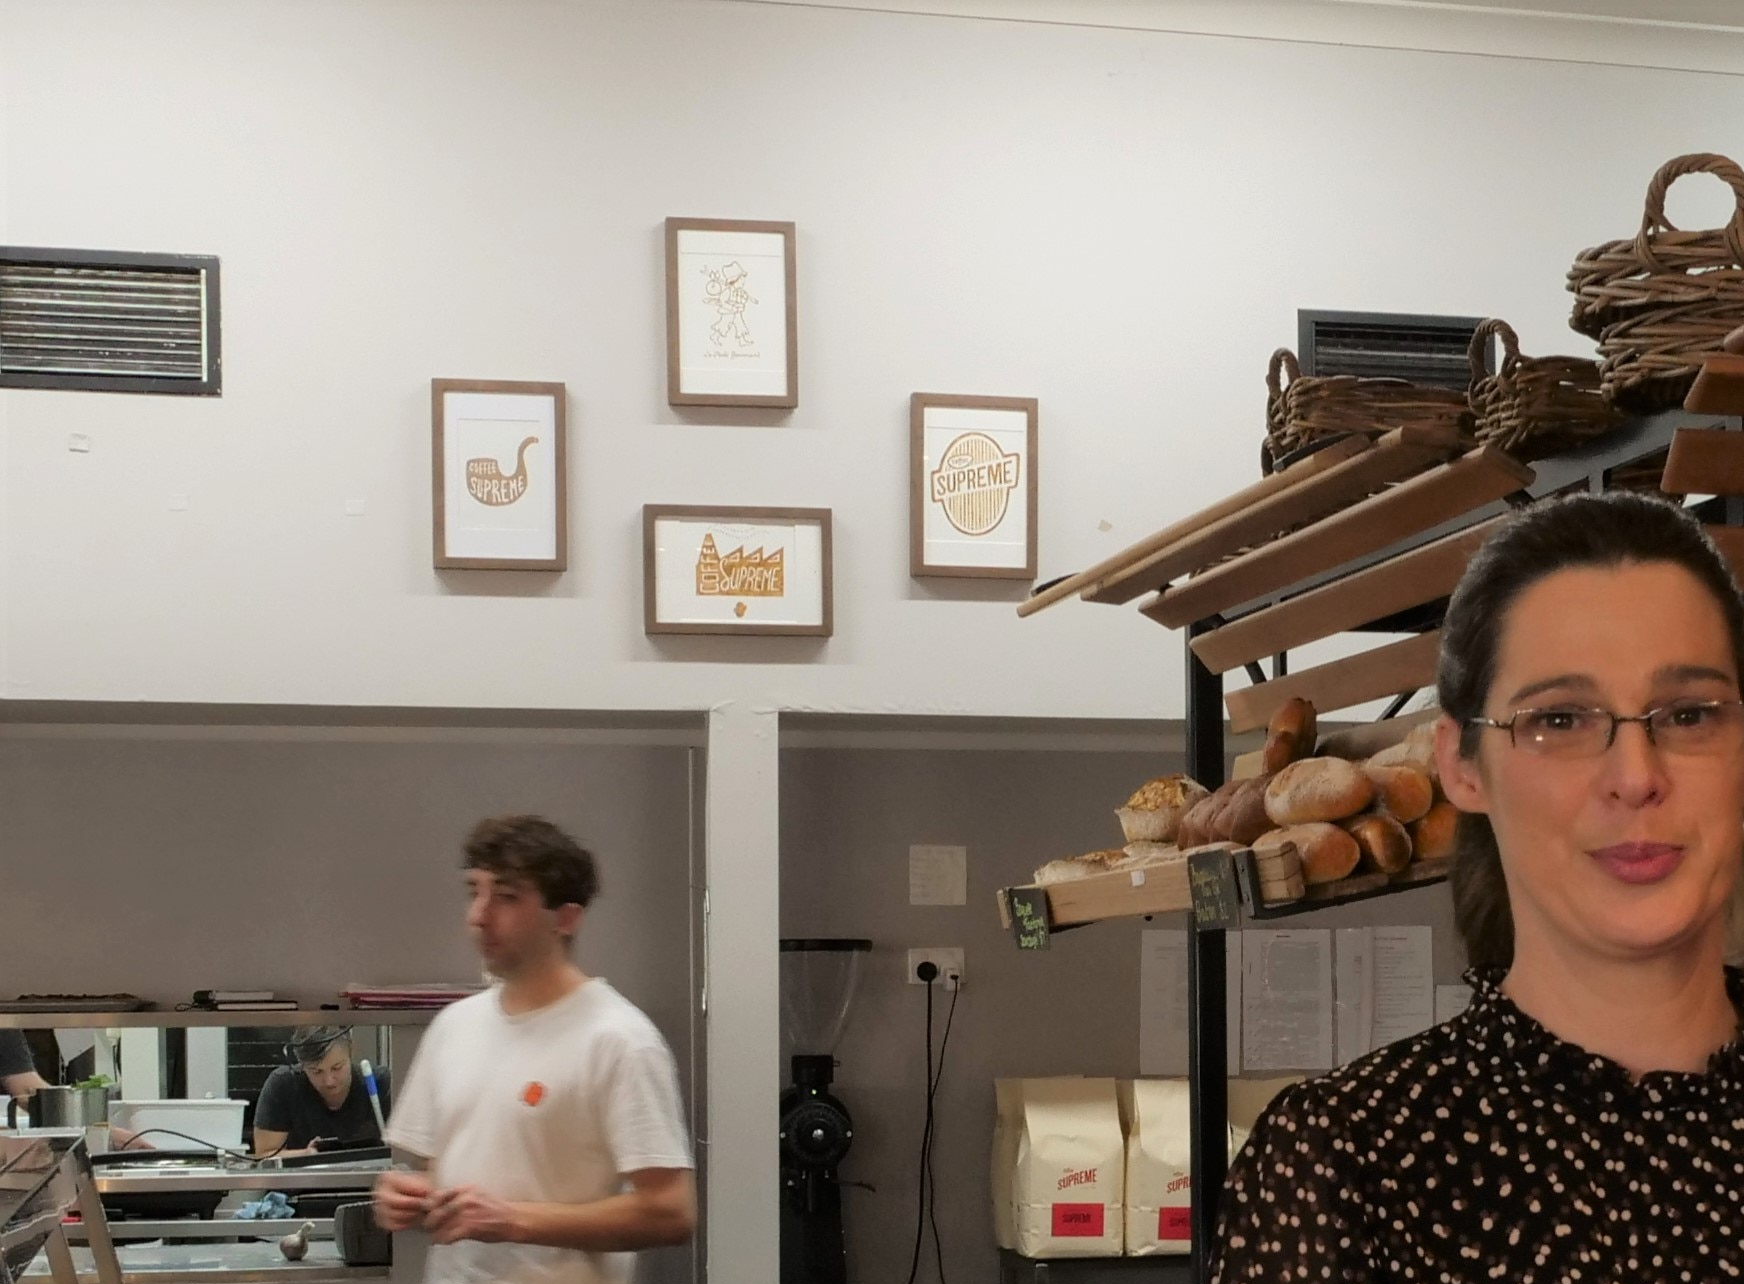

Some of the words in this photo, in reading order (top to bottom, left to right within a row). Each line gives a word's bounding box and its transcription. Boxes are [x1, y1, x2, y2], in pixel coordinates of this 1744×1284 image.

[469, 461, 497, 475] COFFEE
[936, 460, 1013, 497] SUPREME
[470, 475, 525, 504] SUPREME
[699, 536, 720, 594] COFFEE
[1057, 1167, 1098, 1191] SUPREME
